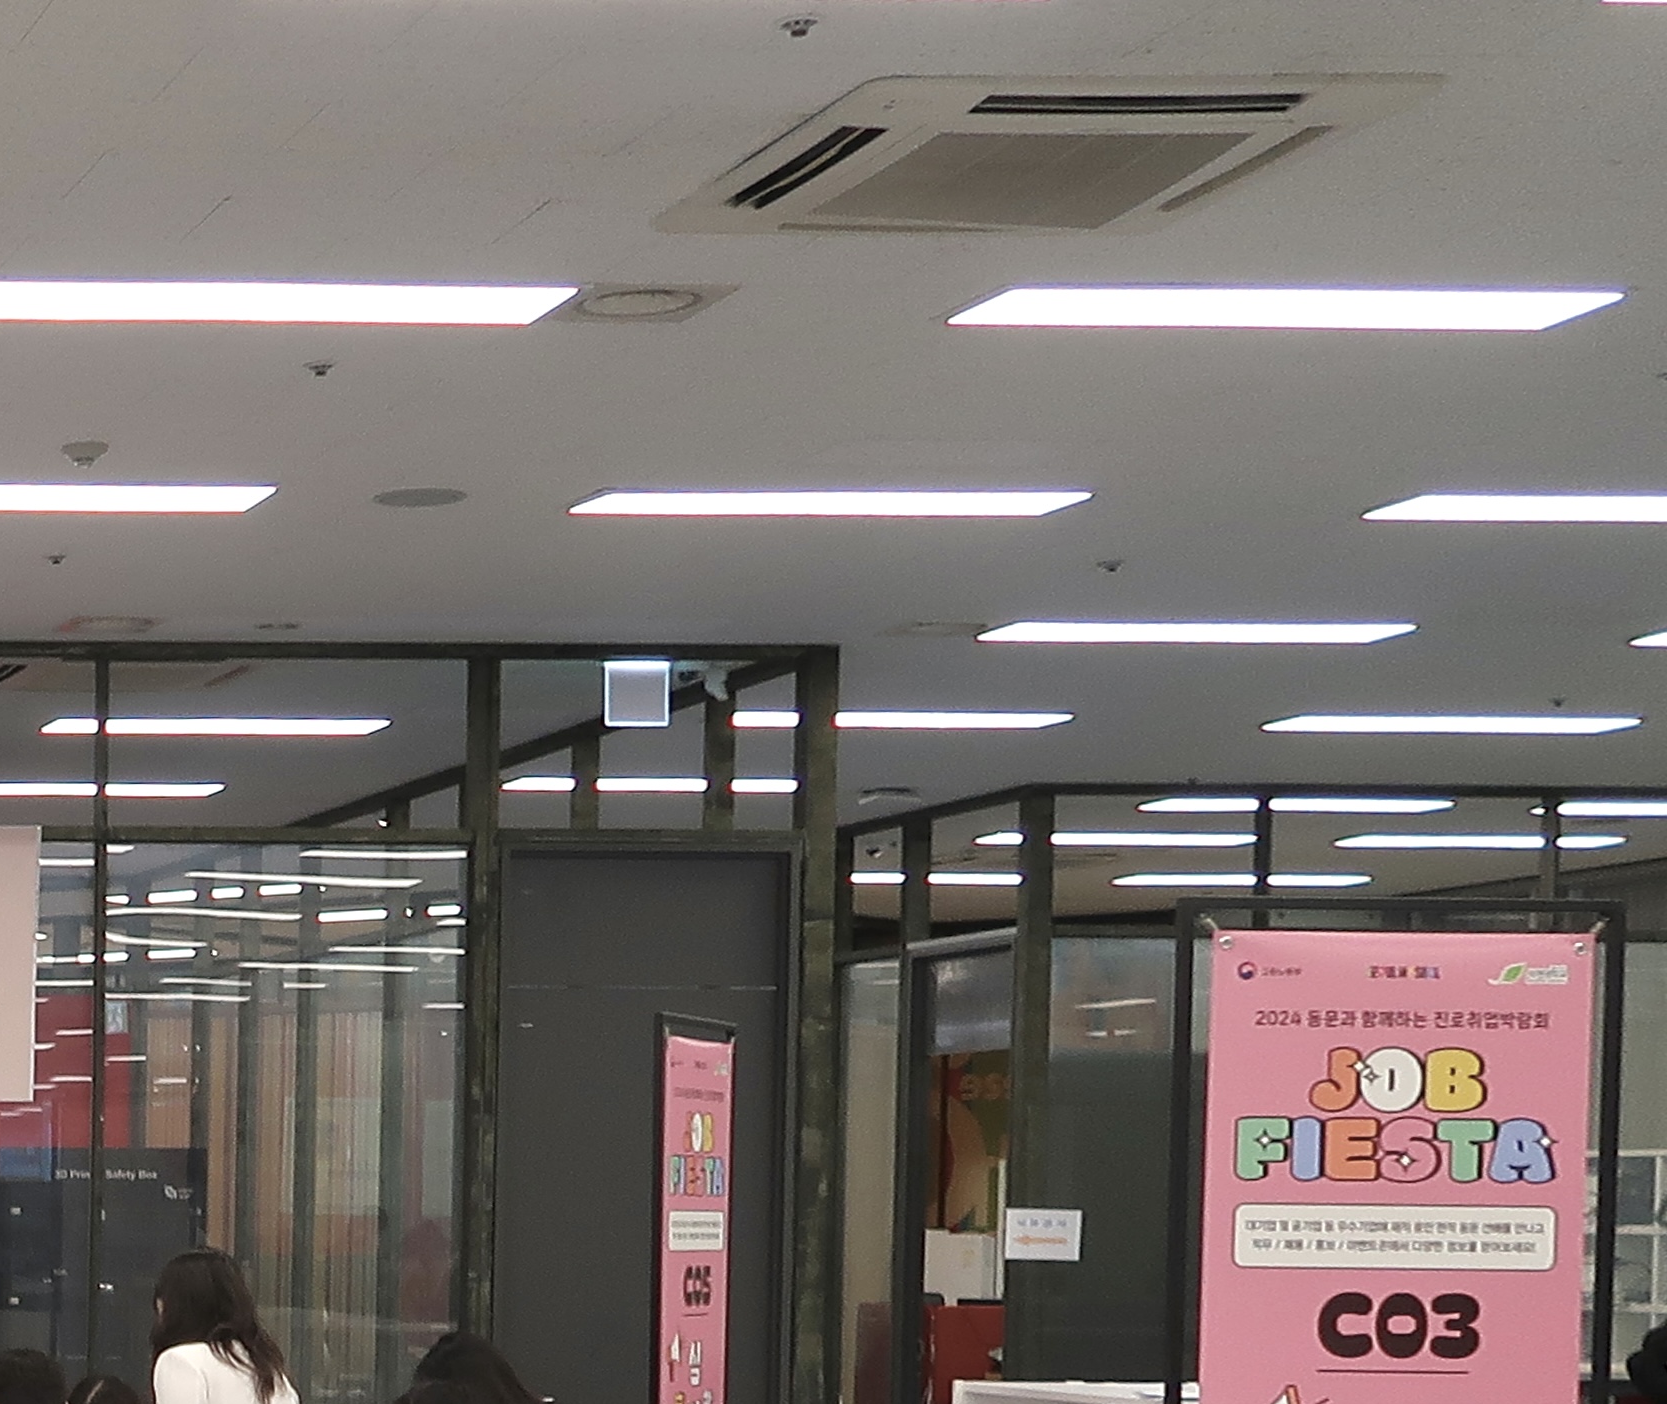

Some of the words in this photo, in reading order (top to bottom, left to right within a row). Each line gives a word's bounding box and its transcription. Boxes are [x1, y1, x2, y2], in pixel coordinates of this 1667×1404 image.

[1254, 1010, 1302, 1027] 2024
[1306, 1010, 1357, 1028] 동문과
[1361, 1010, 1429, 1029] 함께하는
[1433, 1012, 1550, 1030] 진로취업박람회
[1309, 1046, 1486, 1113] JOB
[1234, 1114, 1557, 1185] FIESTA
